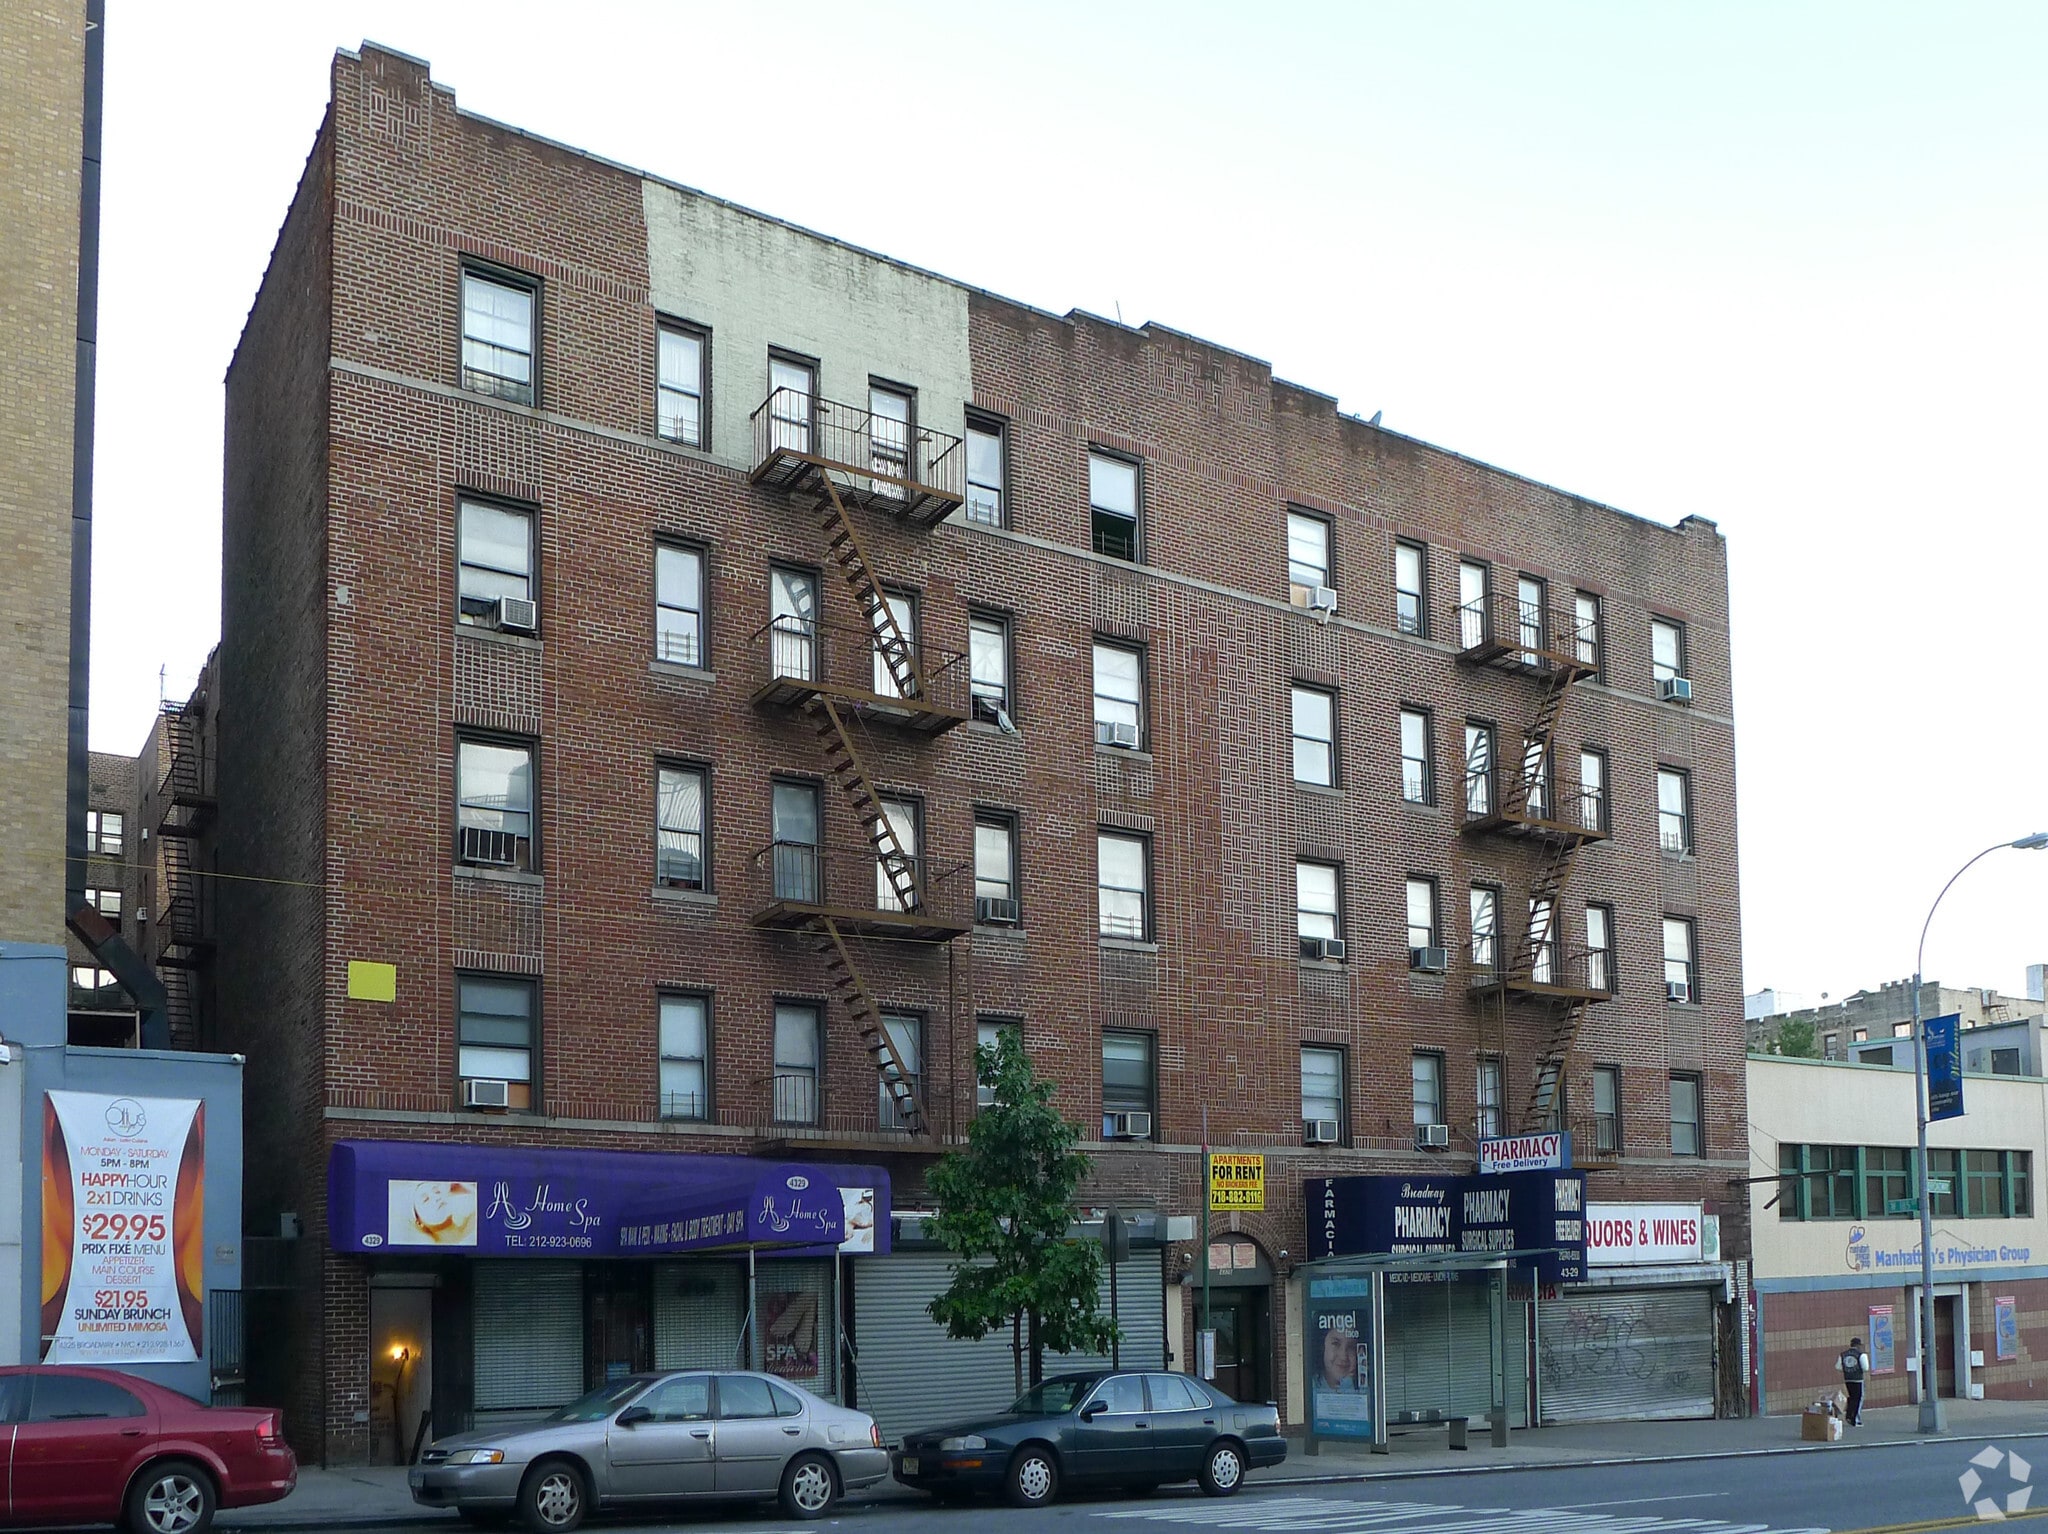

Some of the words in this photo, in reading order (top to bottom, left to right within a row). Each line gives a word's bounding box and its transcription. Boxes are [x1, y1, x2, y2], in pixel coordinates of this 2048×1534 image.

[80, 1146, 121, 1156] MONDAY
[128, 1148, 169, 1158] SATURDAY
[1482, 1136, 1558, 1162] PHARMACY
[100, 1158, 120, 1168] 5PM
[130, 1159, 150, 1168] 8PM
[1214, 1155, 1261, 1165] APARTMENTS
[1492, 1160, 1511, 1169] Free
[1514, 1158, 1548, 1168] Delivery
[1212, 1166, 1232, 1180] FOR
[1236, 1166, 1262, 1180] RENT
[789, 1179, 806, 1188] 4329
[86, 1190, 110, 1204] 2x1
[113, 1190, 163, 1206] DRINKS
[1401, 1182, 1445, 1204] Broadway
[525, 1184, 572, 1212] Home
[569, 1198, 601, 1234] Spa
[1464, 1188, 1510, 1224] PHARMACY
[784, 1198, 818, 1220] Home
[814, 1208, 837, 1235] Spa
[1395, 1206, 1451, 1238] PHARMACY
[82, 1213, 166, 1242] $29.95
[1638, 1218, 1648, 1246] &
[1652, 1219, 1697, 1246] WINES
[505, 1235, 527, 1248] TEL:
[529, 1236, 592, 1248] 212-923-0696
[82, 1243, 106, 1254] PRIX
[133, 1244, 166, 1256] MENU
[1875, 1248, 1945, 1268] Manhattn's
[1948, 1246, 1998, 1266] Physician
[2000, 1245, 2030, 1263] Group
[102, 1256, 145, 1264] APPETIZER
[92, 1265, 116, 1274] MAIN
[118, 1266, 155, 1275] COURSE
[105, 1275, 142, 1284] DESSERT
[94, 1290, 148, 1308] $21.95
[74, 1308, 120, 1320] SUNDAY
[123, 1308, 171, 1320] BRUNCH
[1318, 1310, 1356, 1332] angel
[78, 1322, 126, 1332] UNLIMITED
[128, 1322, 168, 1332] MIMOSA
[766, 1344, 798, 1361] SPA
